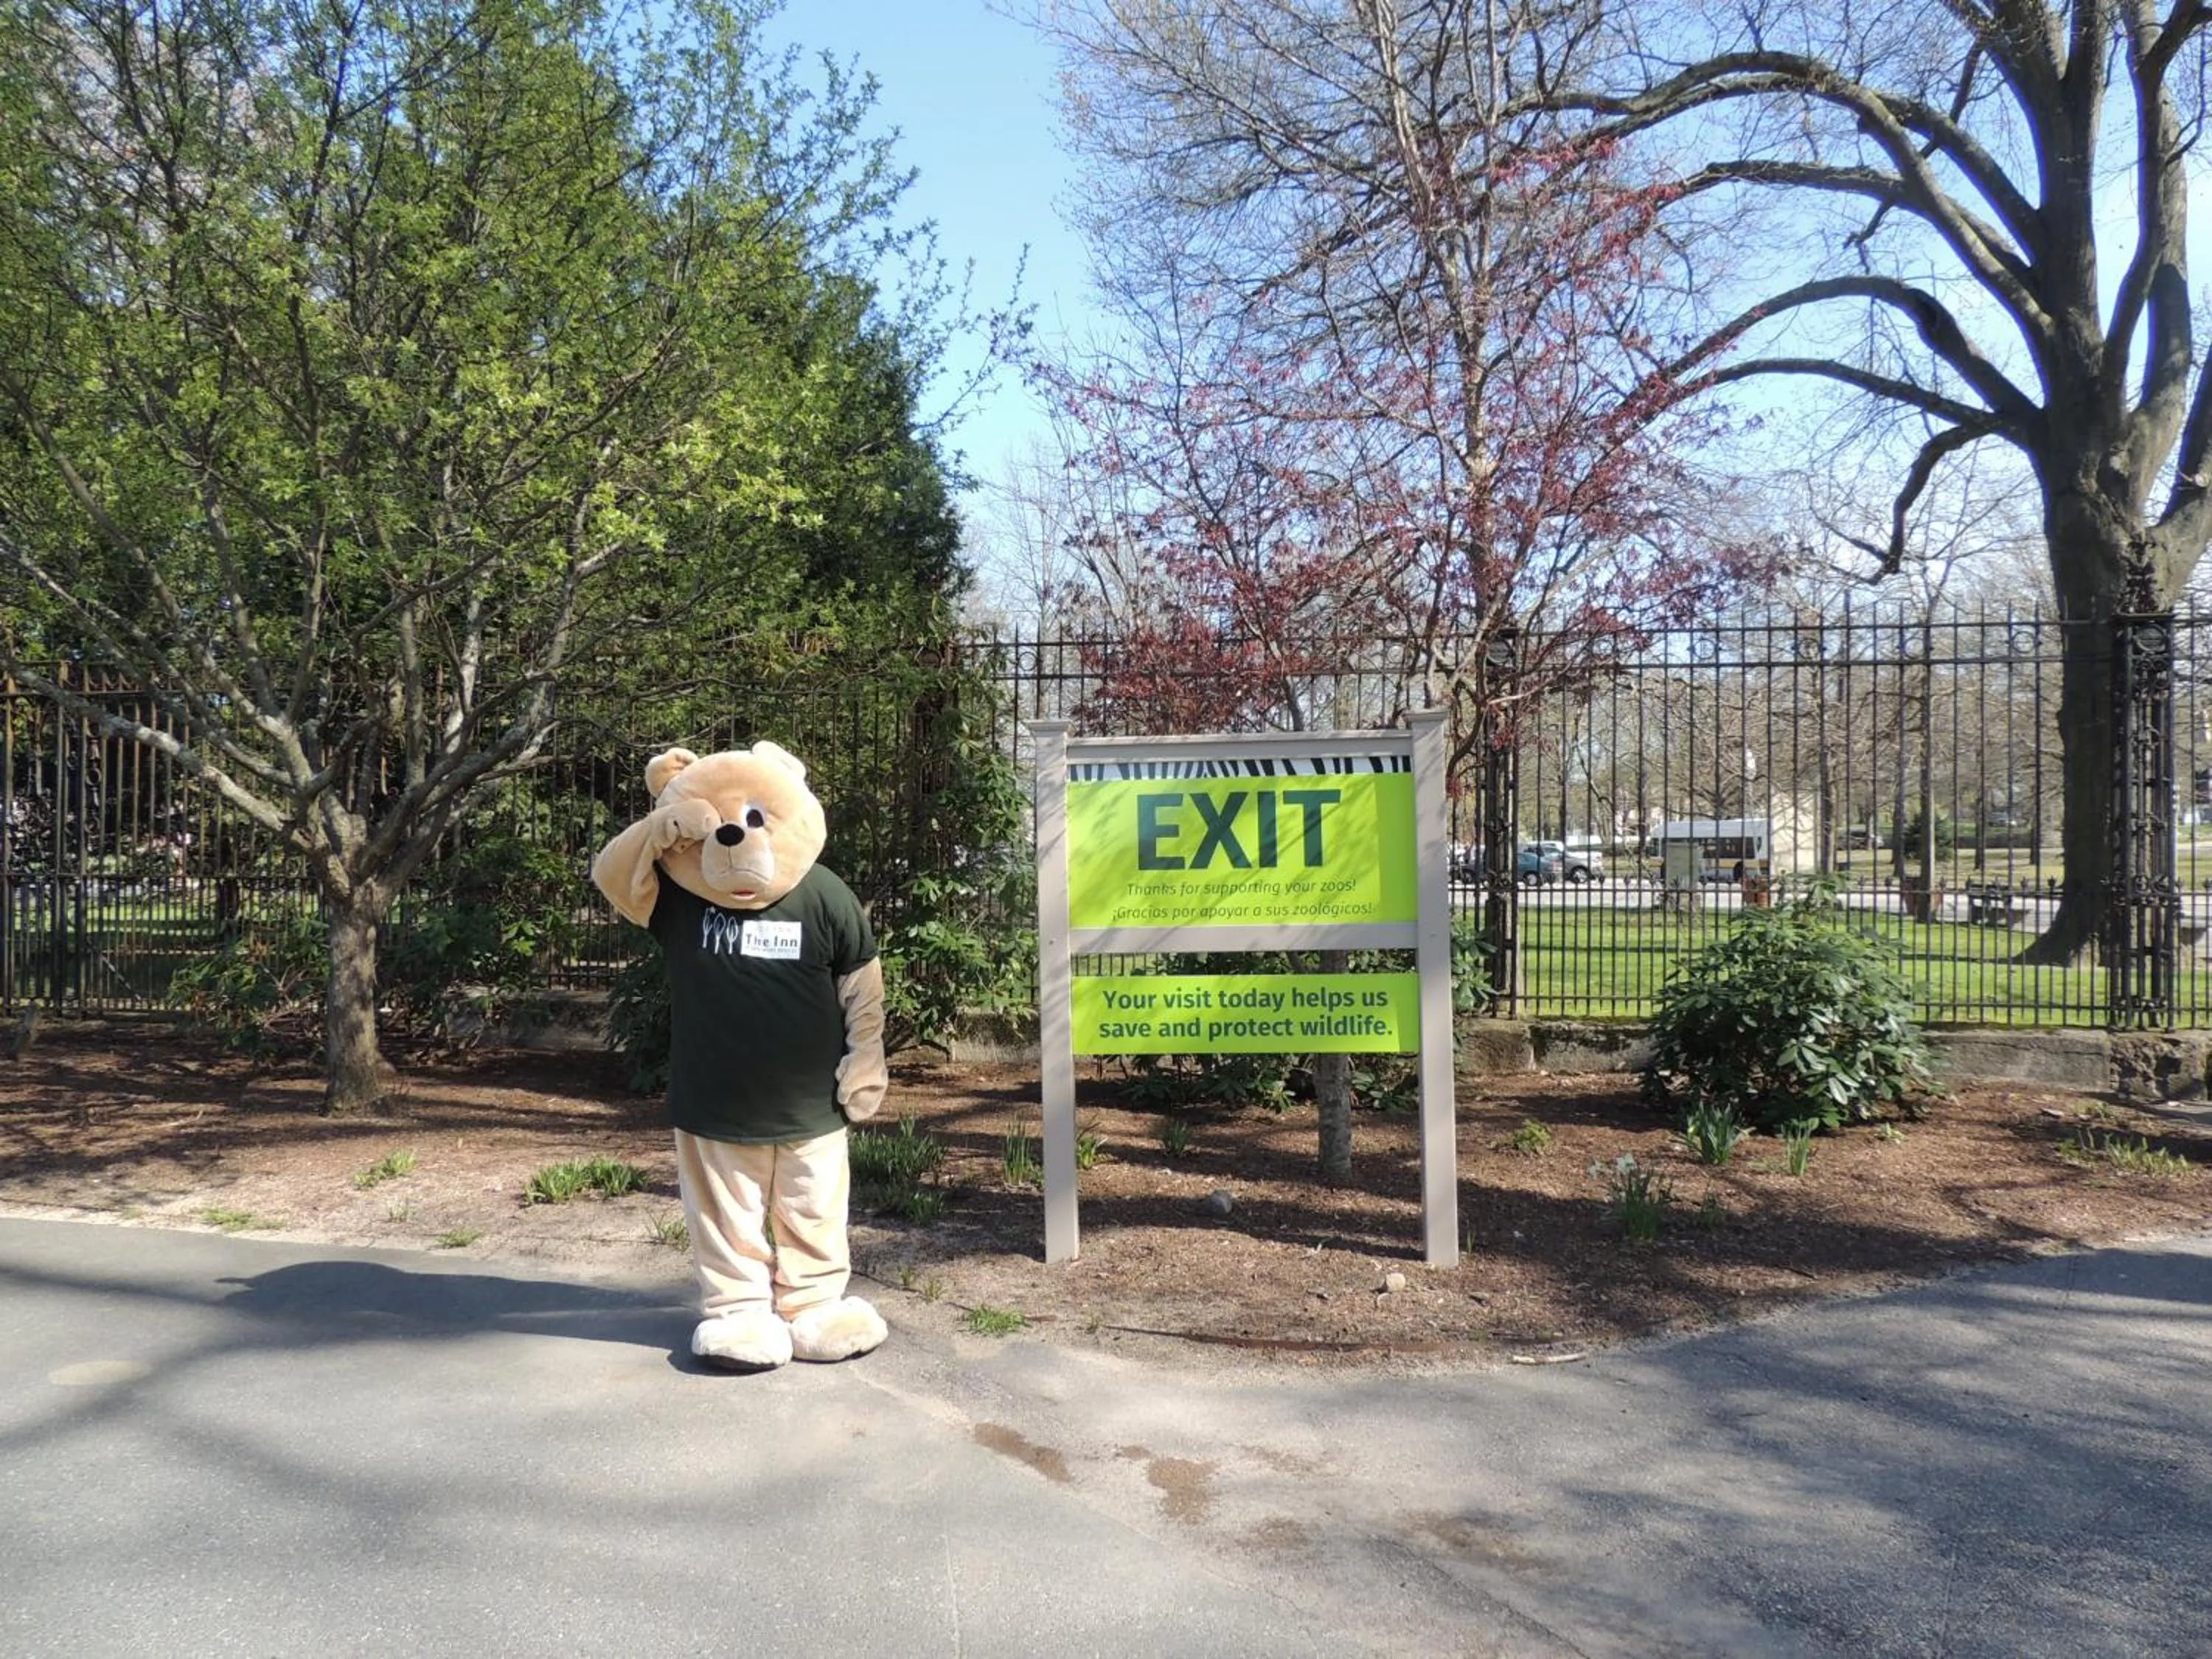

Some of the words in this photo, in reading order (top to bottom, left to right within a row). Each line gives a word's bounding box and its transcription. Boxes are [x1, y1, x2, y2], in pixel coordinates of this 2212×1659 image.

[1137, 789, 1341, 871] EXIT
[1128, 883, 1176, 895] Thanks
[1179, 882, 1199, 896] for
[1203, 880, 1280, 896] supporting
[1285, 881, 1316, 894] your
[1321, 879, 1356, 891] zoos!
[1172, 907, 1196, 920] por
[1200, 906, 1248, 919] apoyar
[1253, 905, 1262, 917] a
[1265, 905, 1289, 916] sus
[746, 933, 769, 947] The
[773, 934, 799, 947] Inn
[1103, 990, 1157, 1009] Your
[1163, 987, 1211, 1008] visit
[1218, 987, 1284, 1012] today
[1292, 986, 1355, 1012] helps
[1362, 991, 1388, 1006] us
[1099, 1021, 1151, 1038] save
[1158, 1017, 1200, 1037] and
[1208, 1018, 1293, 1042] protect
[1300, 1014, 1393, 1036] wildlife.
